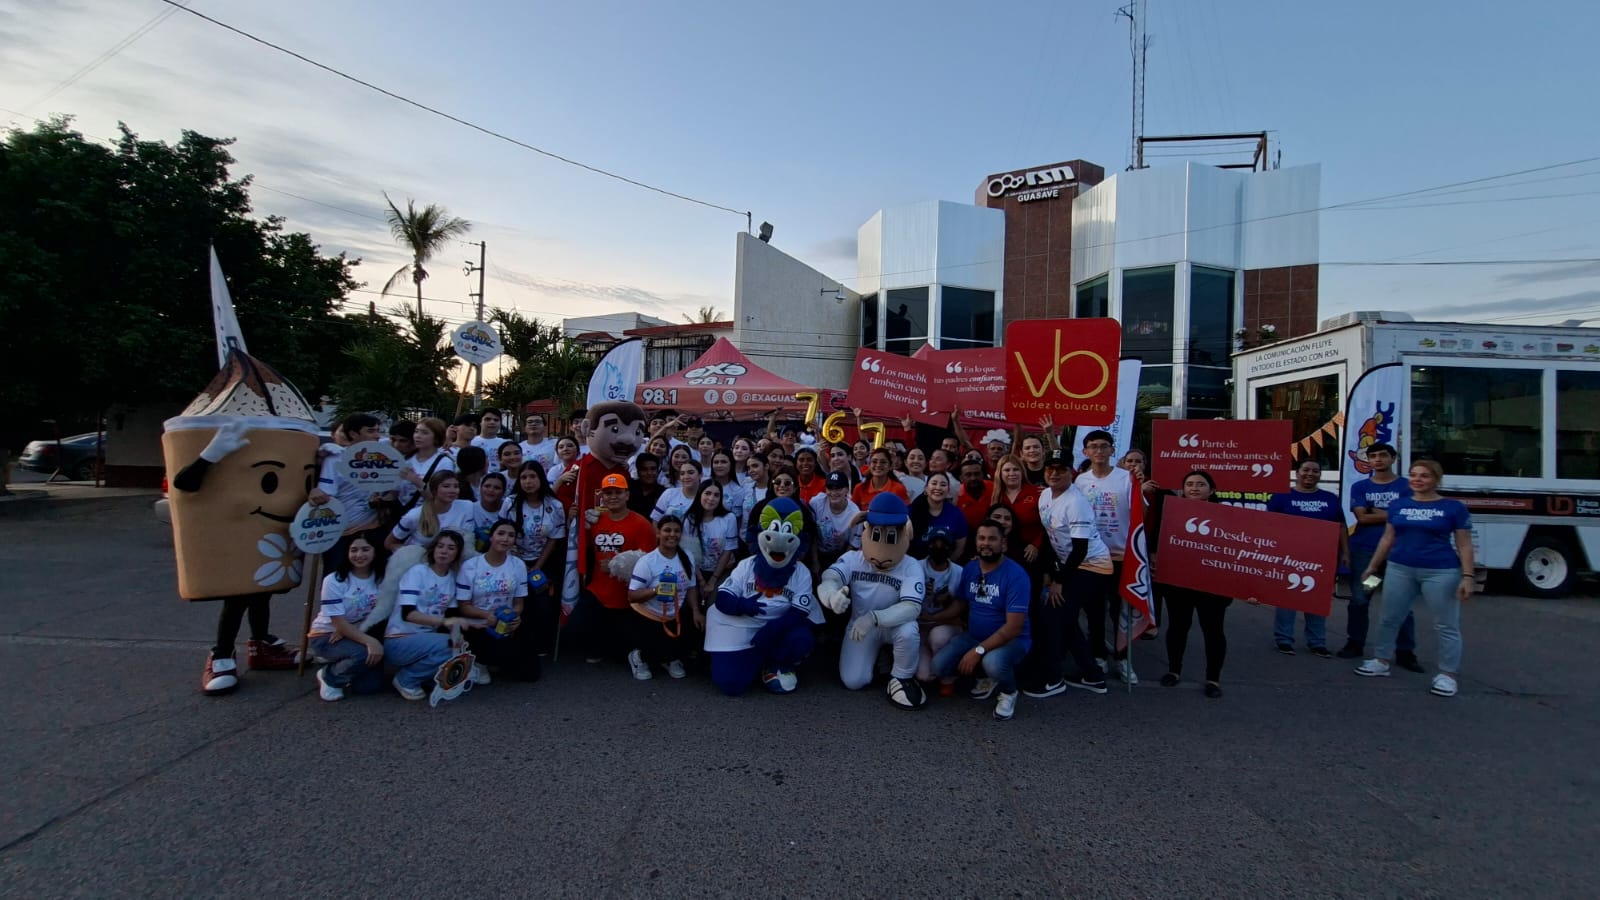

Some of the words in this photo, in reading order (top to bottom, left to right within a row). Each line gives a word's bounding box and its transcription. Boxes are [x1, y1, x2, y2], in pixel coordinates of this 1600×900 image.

[1018, 189, 1059, 202] GUASAVE
[1264, 344, 1310, 360] COMUNICACIÓN
[1312, 339, 1332, 350] FLUYE
[1259, 362, 1275, 371] TODO
[1283, 355, 1308, 366] ESTADO
[1308, 352, 1324, 361] CON
[1324, 348, 1339, 358] RSN
[881, 366, 897, 377] Los
[870, 376, 904, 390] también
[904, 385, 926, 396] cuen
[642, 388, 678, 405] 98.1
[742, 392, 797, 404] @EXAGUAS
[884, 390, 919, 406] historias
[1012, 400, 1050, 410] valdez
[1054, 401, 1108, 412] baluarte
[796, 392, 820, 424] 7
[822, 410, 846, 443] 6
[860, 422, 886, 450] 7
[1202, 440, 1226, 448] Parte
[1226, 440, 1239, 448] de
[1160, 450, 1170, 458] tu
[1208, 450, 1242, 460] incluso
[1243, 452, 1268, 460] antes
[1270, 452, 1282, 460] de
[1190, 463, 1208, 472] que
[1213, 527, 1252, 544] Desde
[1253, 538, 1278, 549] que
[1169, 534, 1222, 553] formaste
[1224, 545, 1236, 556] tu
[1237, 549, 1282, 564] primer
[1201, 557, 1264, 577] estuvimos
[969, 582, 1000, 597] RAOTÓN
